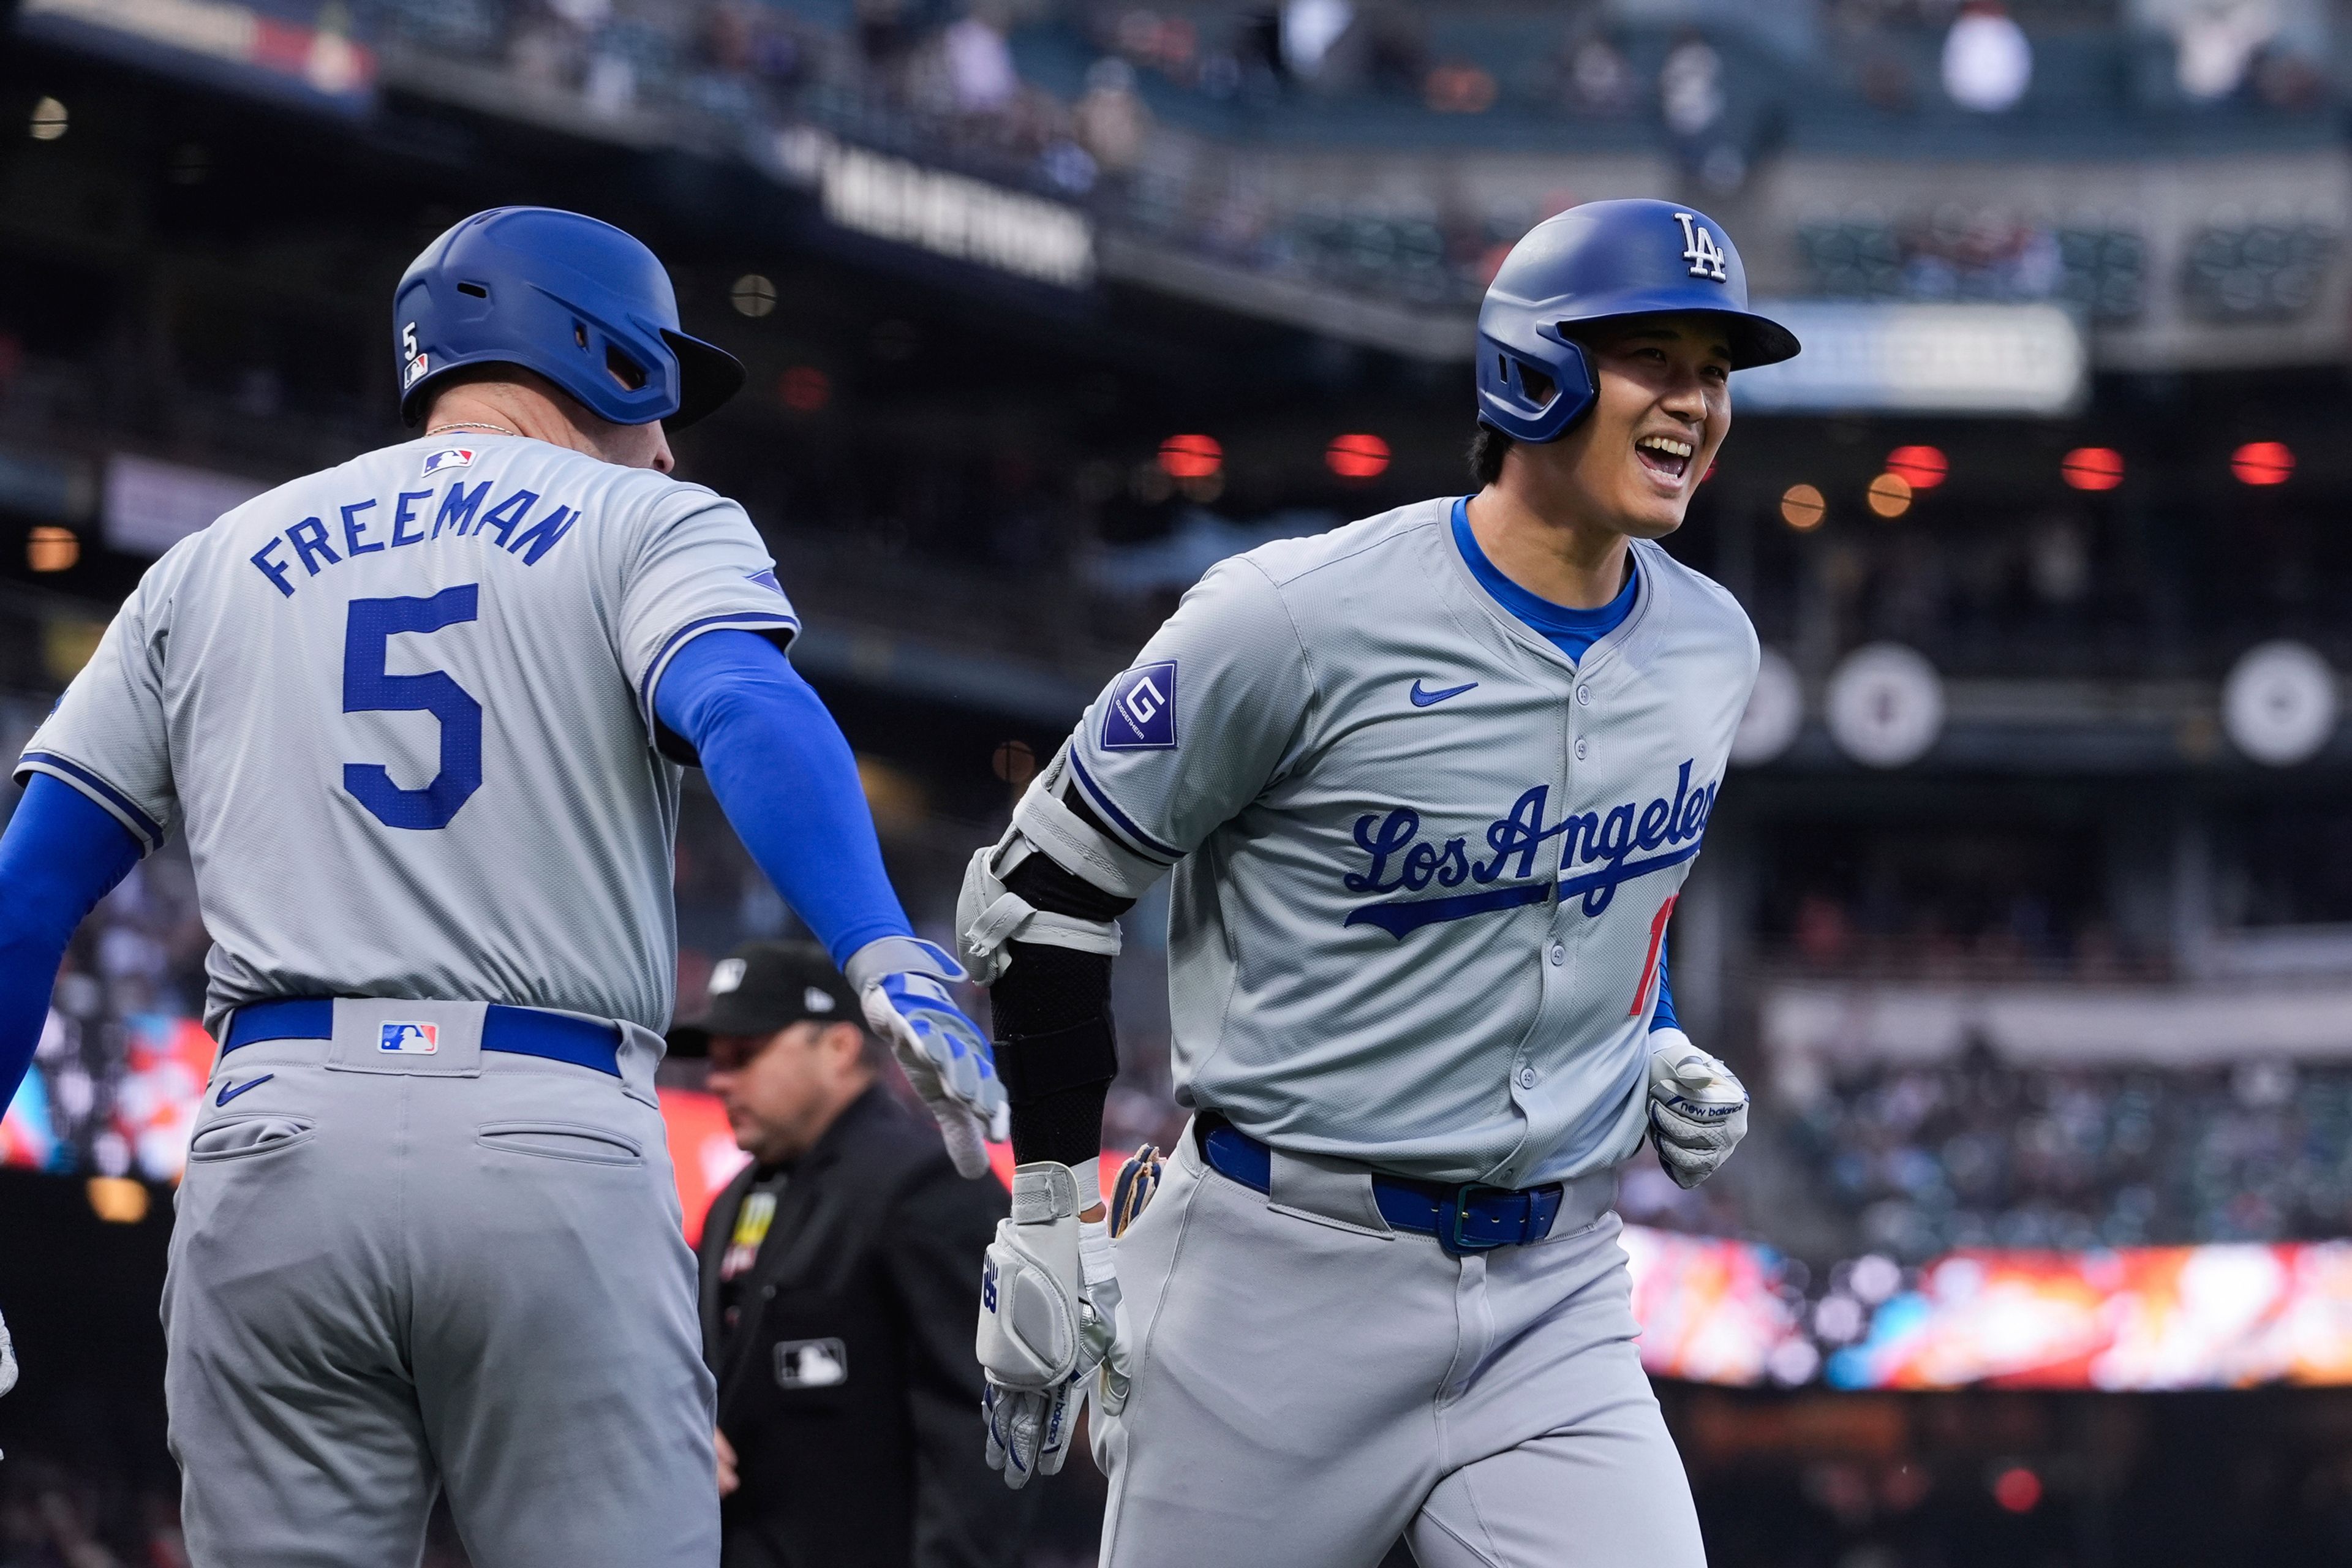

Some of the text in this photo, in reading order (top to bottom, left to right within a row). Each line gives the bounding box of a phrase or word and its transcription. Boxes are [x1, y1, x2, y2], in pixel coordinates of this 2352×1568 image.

[1673, 212, 1727, 282] LA
[402, 321, 418, 361] 5
[250, 480, 582, 599] FREEMAN
[342, 582, 483, 831] 5
[1115, 698, 1145, 741] GUGGENHEIM
[1125, 676, 1166, 724] G
[1343, 807, 1470, 893] Los
[1629, 893, 1681, 1016] 1
[1681, 1102, 1744, 1117] new balance
